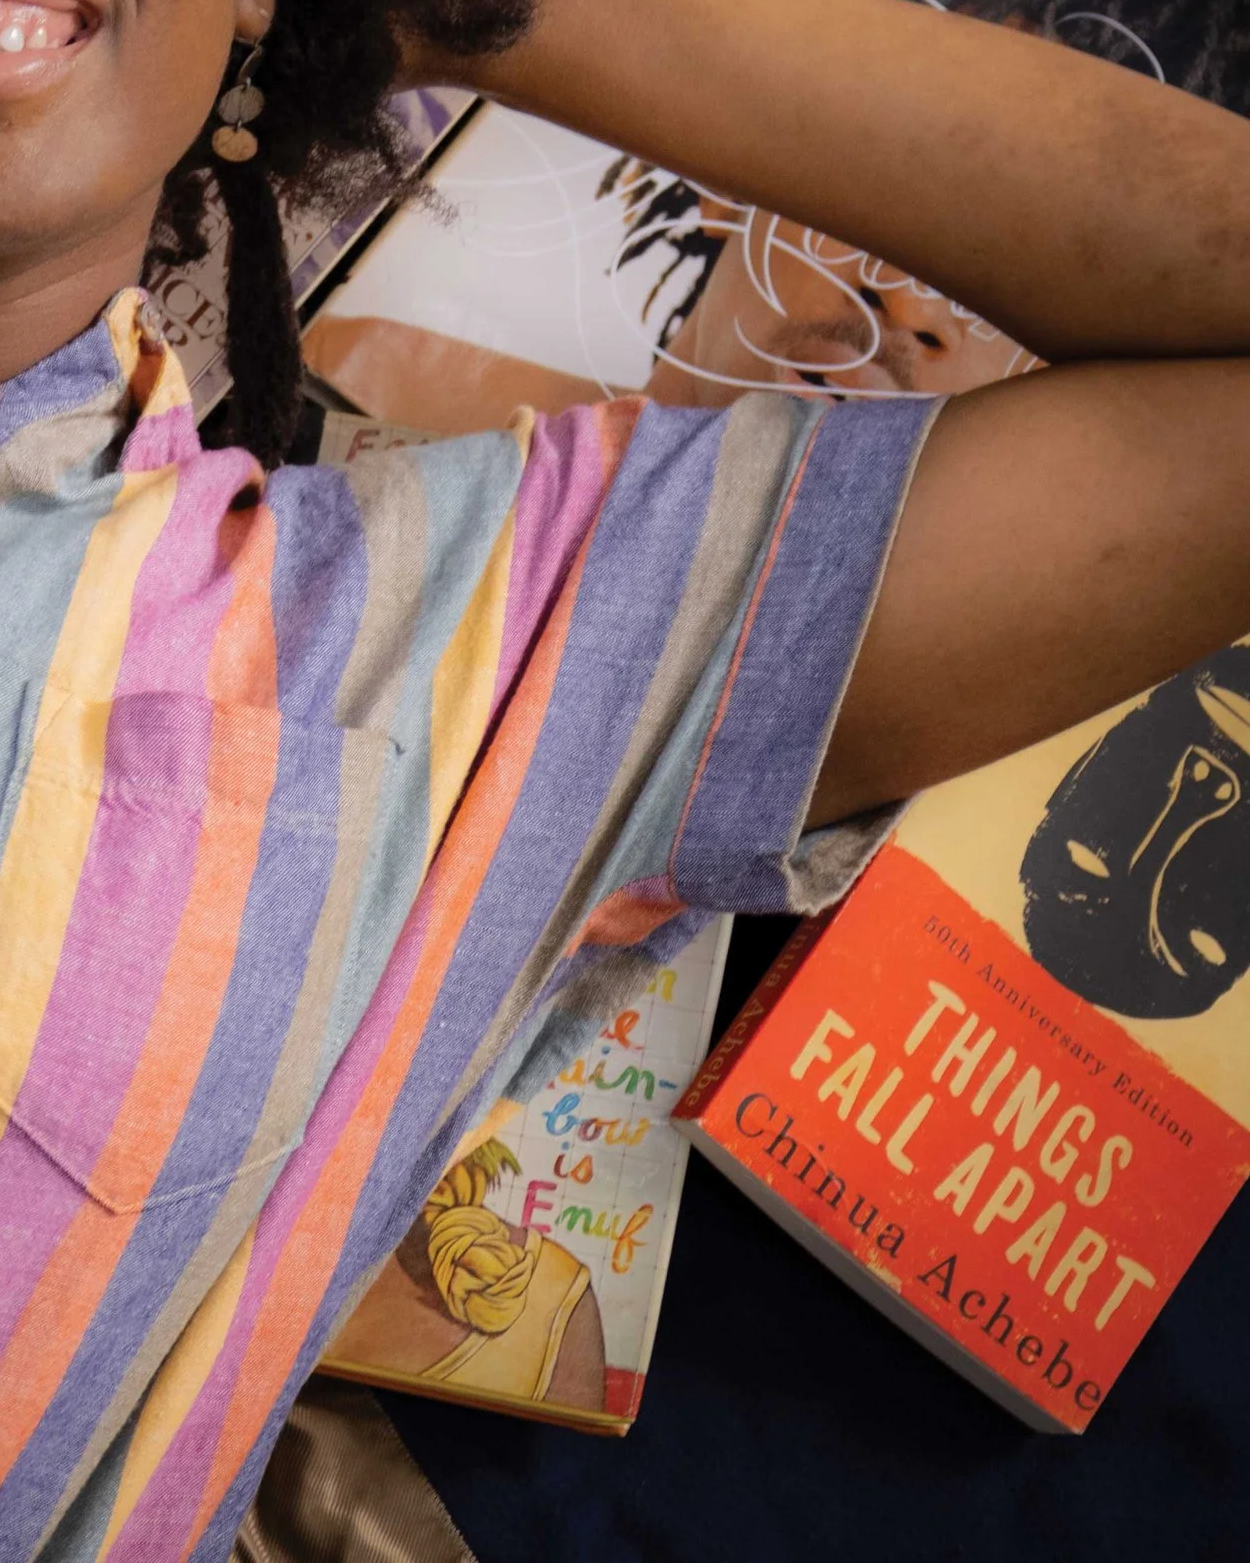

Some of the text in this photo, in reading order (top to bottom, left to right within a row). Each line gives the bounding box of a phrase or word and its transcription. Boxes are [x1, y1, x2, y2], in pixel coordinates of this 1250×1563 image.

[685, 922, 821, 1107] inua Achebe
[902, 980, 1133, 1208] THINGS
[923, 915, 1195, 1148] 50th Anniversary Edition
[543, 1092, 652, 1147] bow
[553, 1140, 594, 1184] is
[789, 1008, 1156, 1332] FALL APART
[520, 1180, 654, 1274] Enuf
[735, 1092, 1104, 1413] Chinua Achebe
